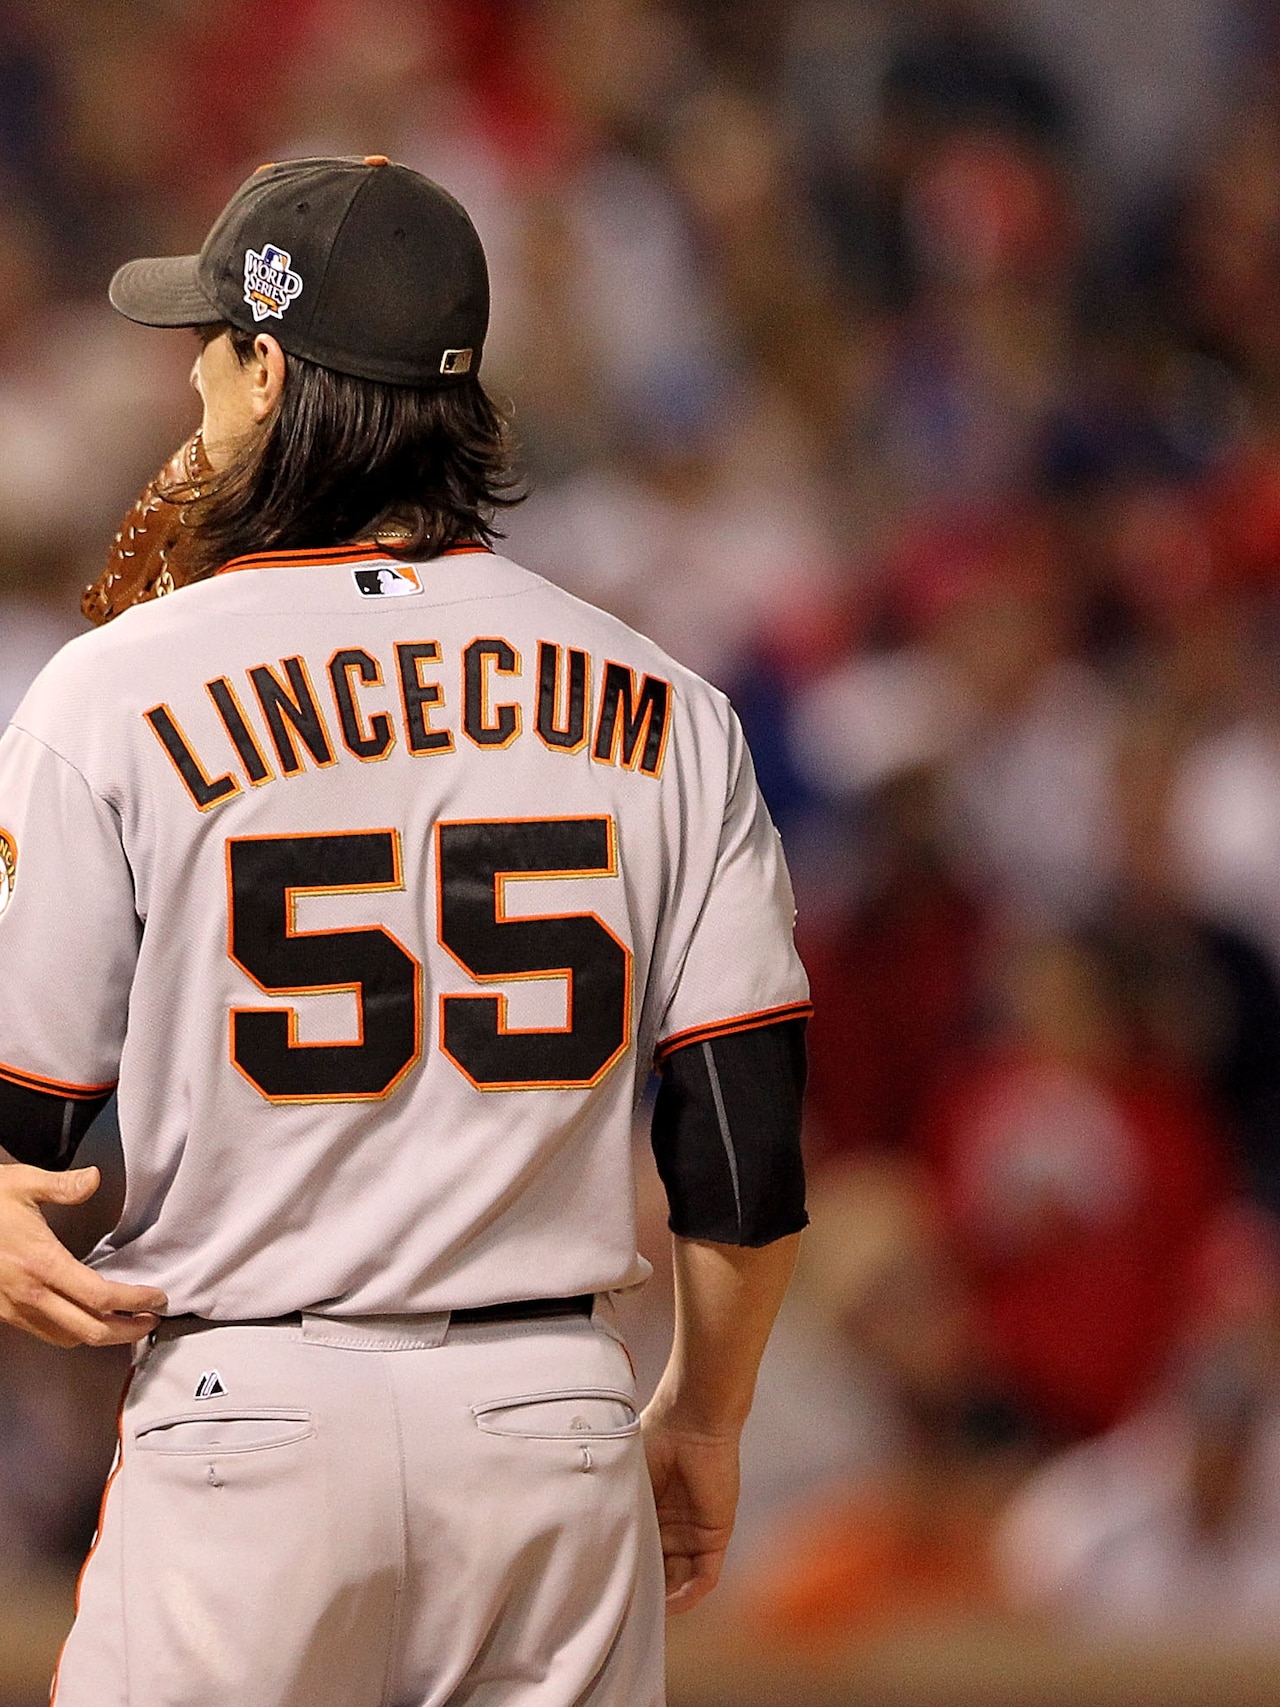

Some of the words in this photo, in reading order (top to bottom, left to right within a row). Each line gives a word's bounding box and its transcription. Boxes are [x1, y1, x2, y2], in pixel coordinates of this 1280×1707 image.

[248, 254, 299, 293] WORLD
[248, 273, 287, 305] SERIES
[143, 637, 672, 812] LINCECUM
[226, 815, 633, 1104] 55
